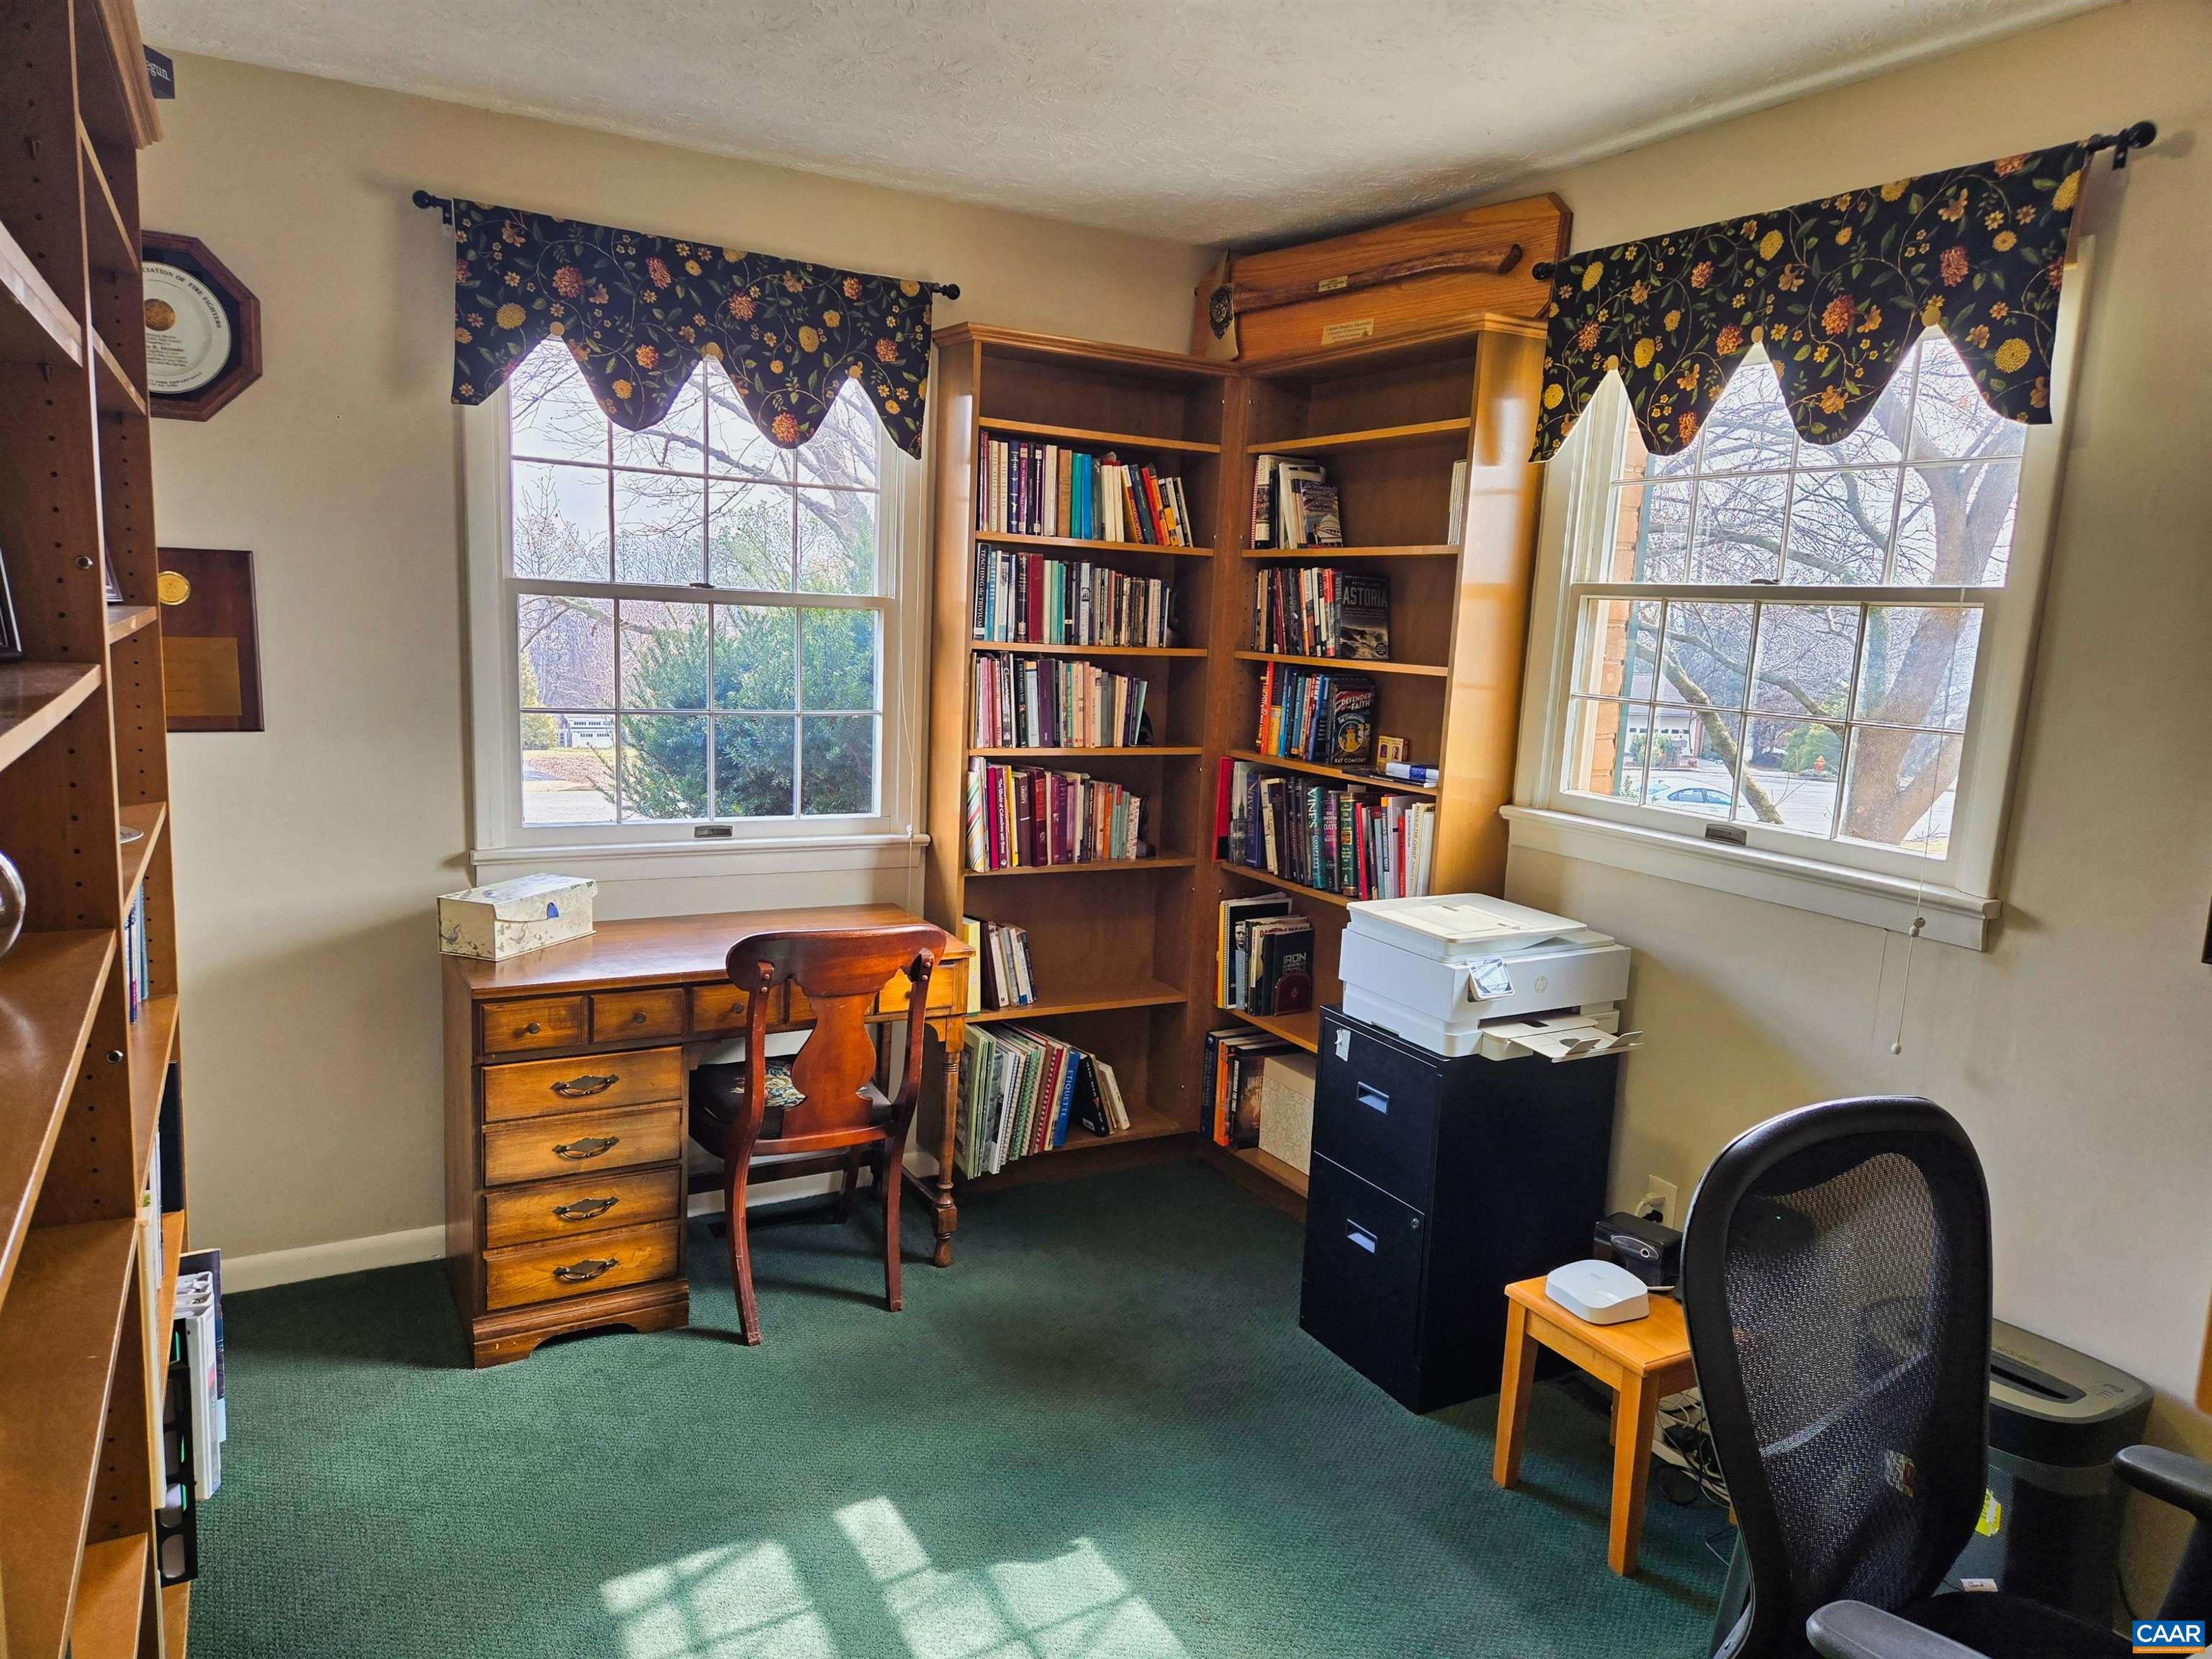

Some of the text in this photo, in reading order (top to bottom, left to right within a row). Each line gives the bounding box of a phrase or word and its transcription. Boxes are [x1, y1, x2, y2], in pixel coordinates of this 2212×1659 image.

[188, 282, 203, 297] FIRE
[202, 297, 221, 328] FIGHTERS
[1343, 586, 1388, 607] ASTORIA
[1341, 693, 1372, 706] DEFENDER
[1351, 699, 1370, 711] FAITH
[1307, 787, 1318, 828] VINE'S
[1283, 952, 1306, 963] IRON
[1061, 1070, 1074, 1117] ETIQUETTE
